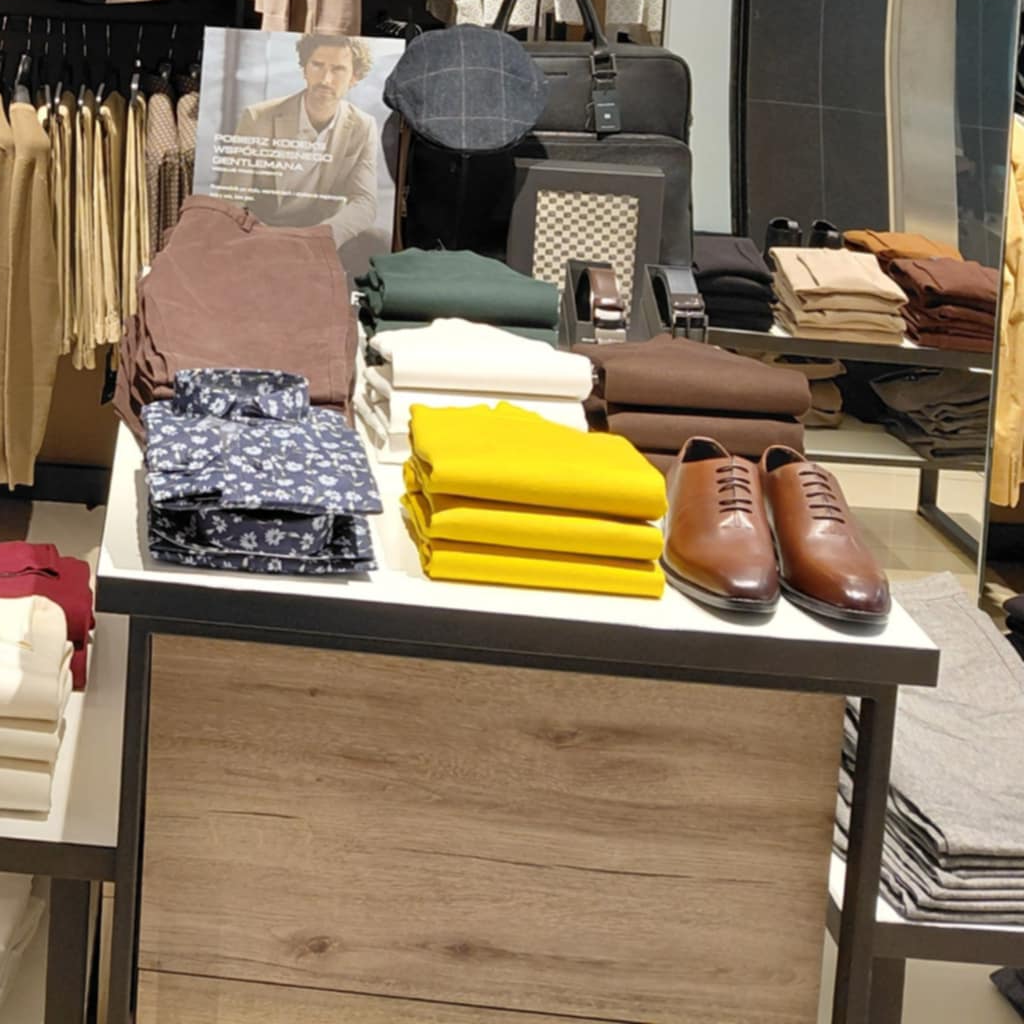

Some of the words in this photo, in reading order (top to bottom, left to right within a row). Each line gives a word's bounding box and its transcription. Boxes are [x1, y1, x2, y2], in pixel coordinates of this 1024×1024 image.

[213, 133, 270, 147] POBIERZ
[272, 138, 327, 152] KODEKS
[212, 155, 305, 172] GENTLEMANA
